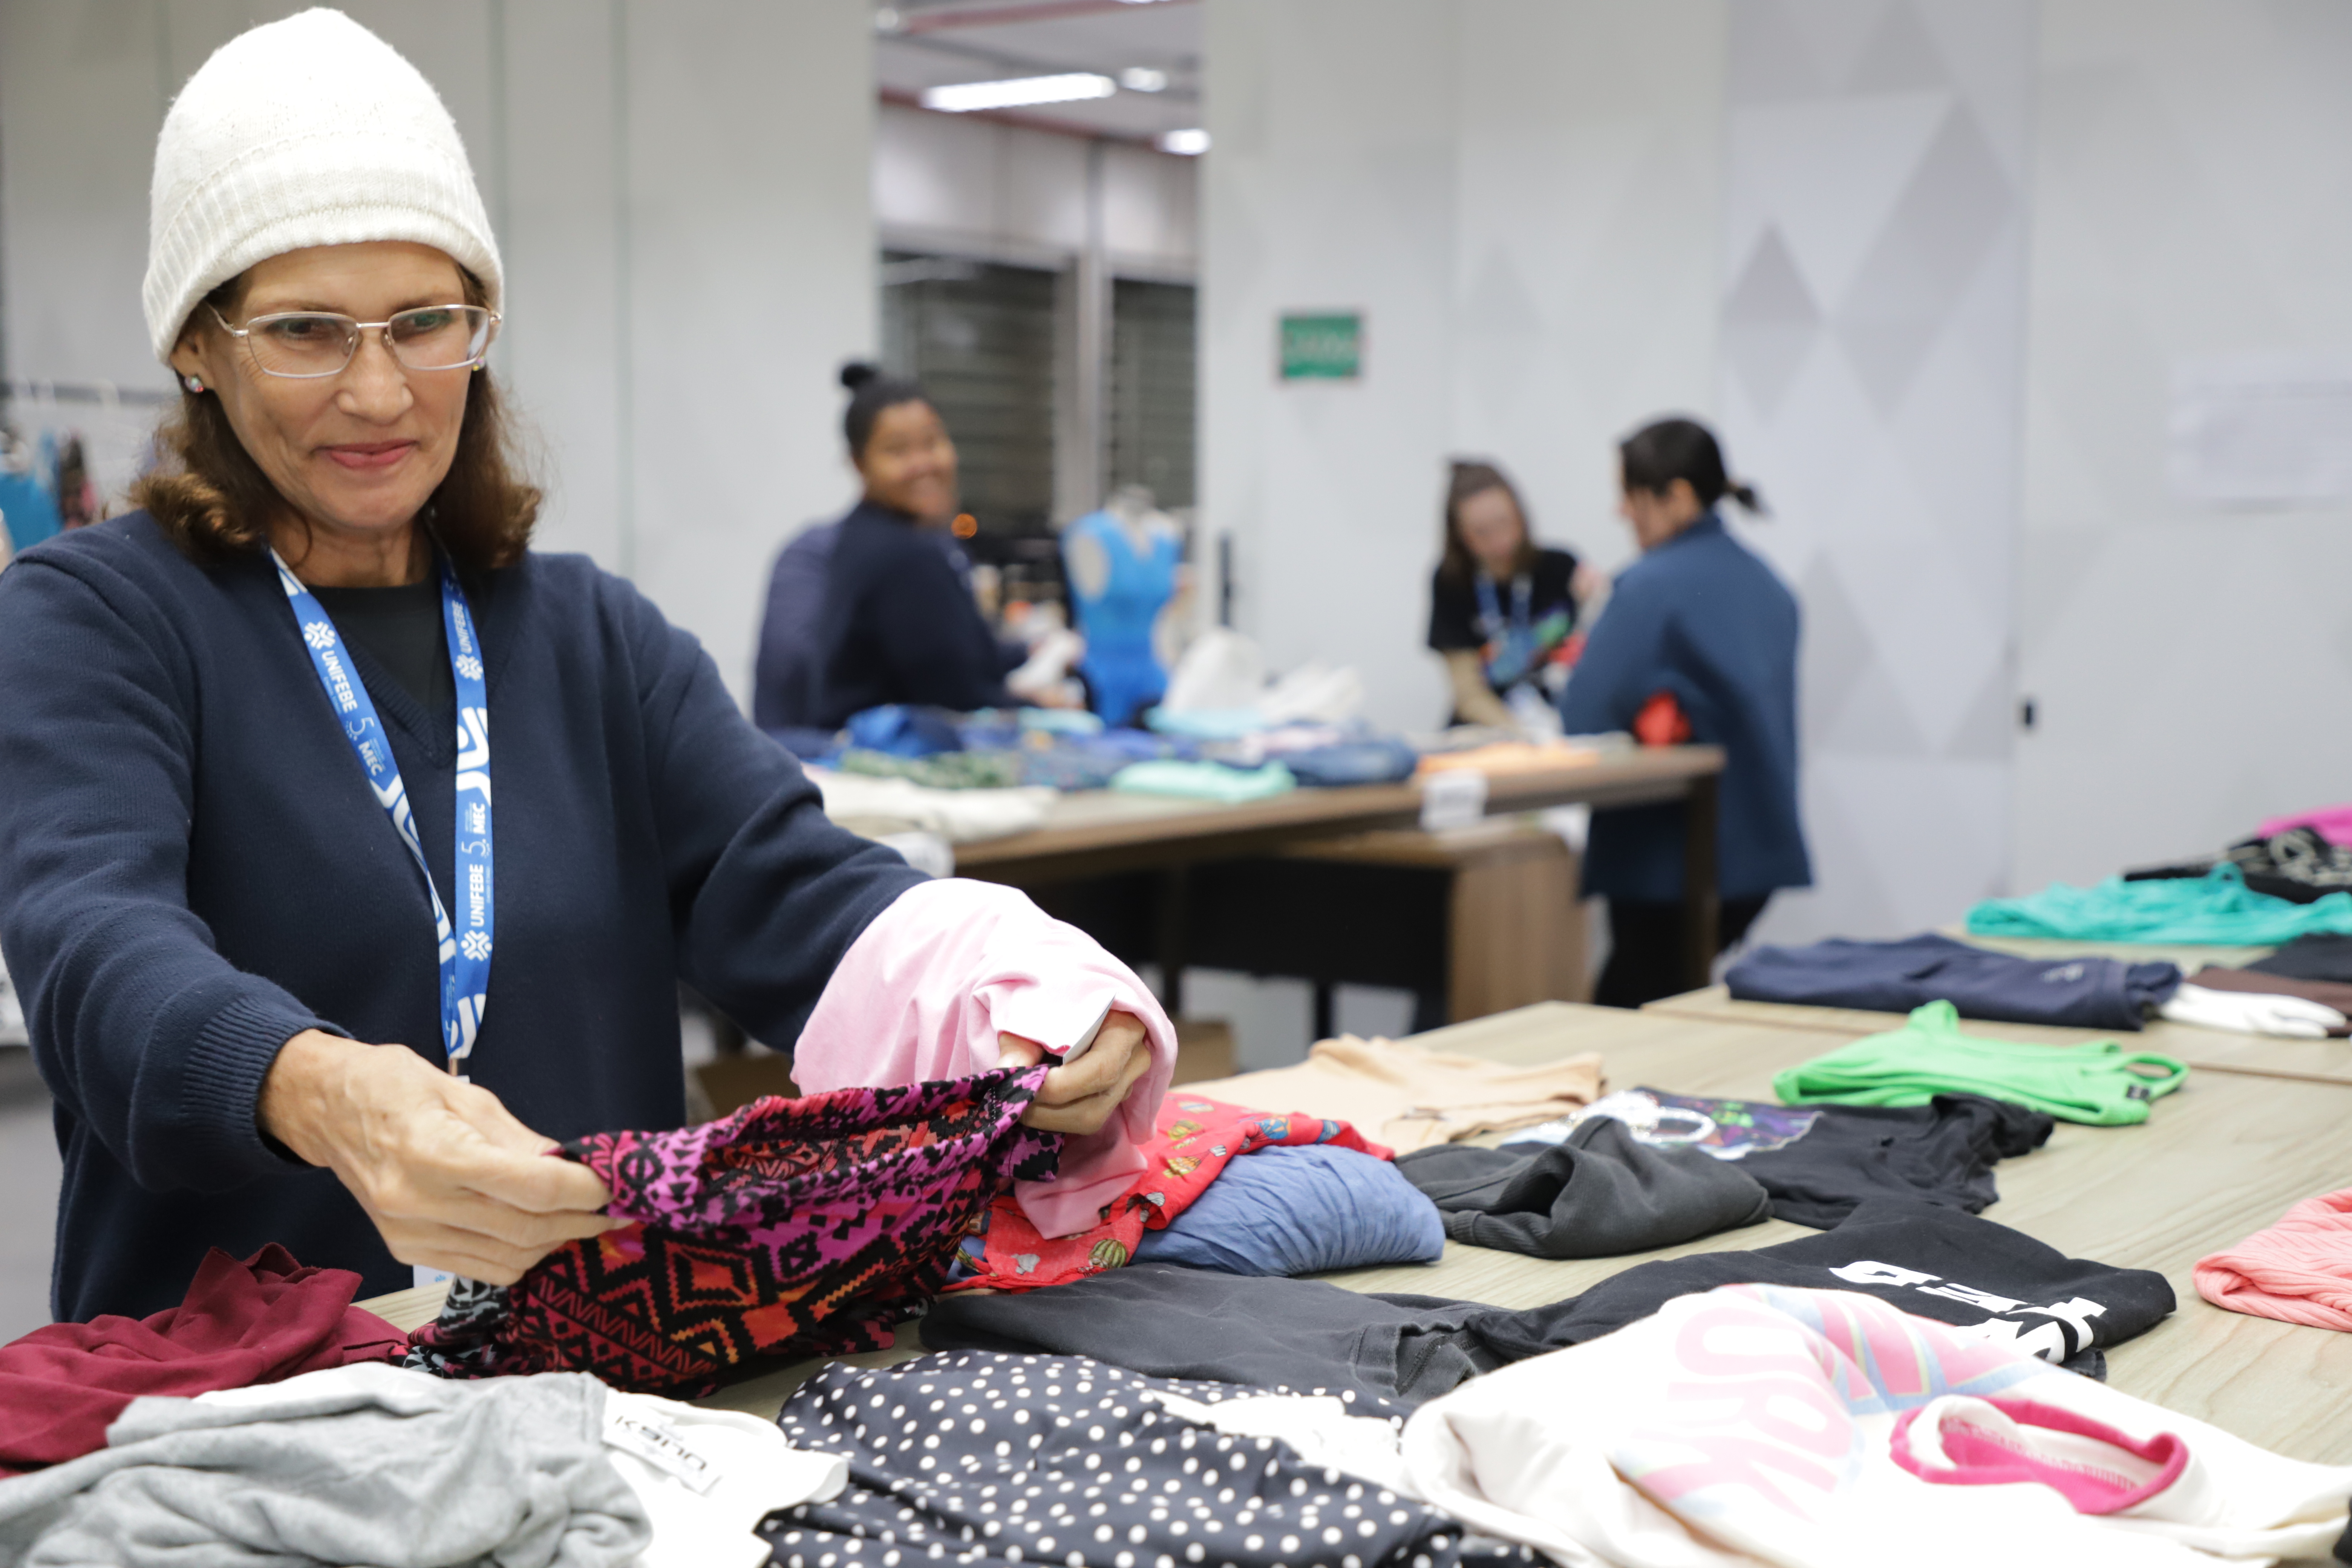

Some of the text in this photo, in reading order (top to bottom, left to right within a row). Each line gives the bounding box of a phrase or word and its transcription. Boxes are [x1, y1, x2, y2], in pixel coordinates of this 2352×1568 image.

[452, 600, 472, 653] UNIFEBE
[322, 650, 358, 713] UNIFEBE
[358, 741, 383, 776] MEC
[472, 802, 485, 835] MEC
[469, 864, 484, 927] UNIFEBE
